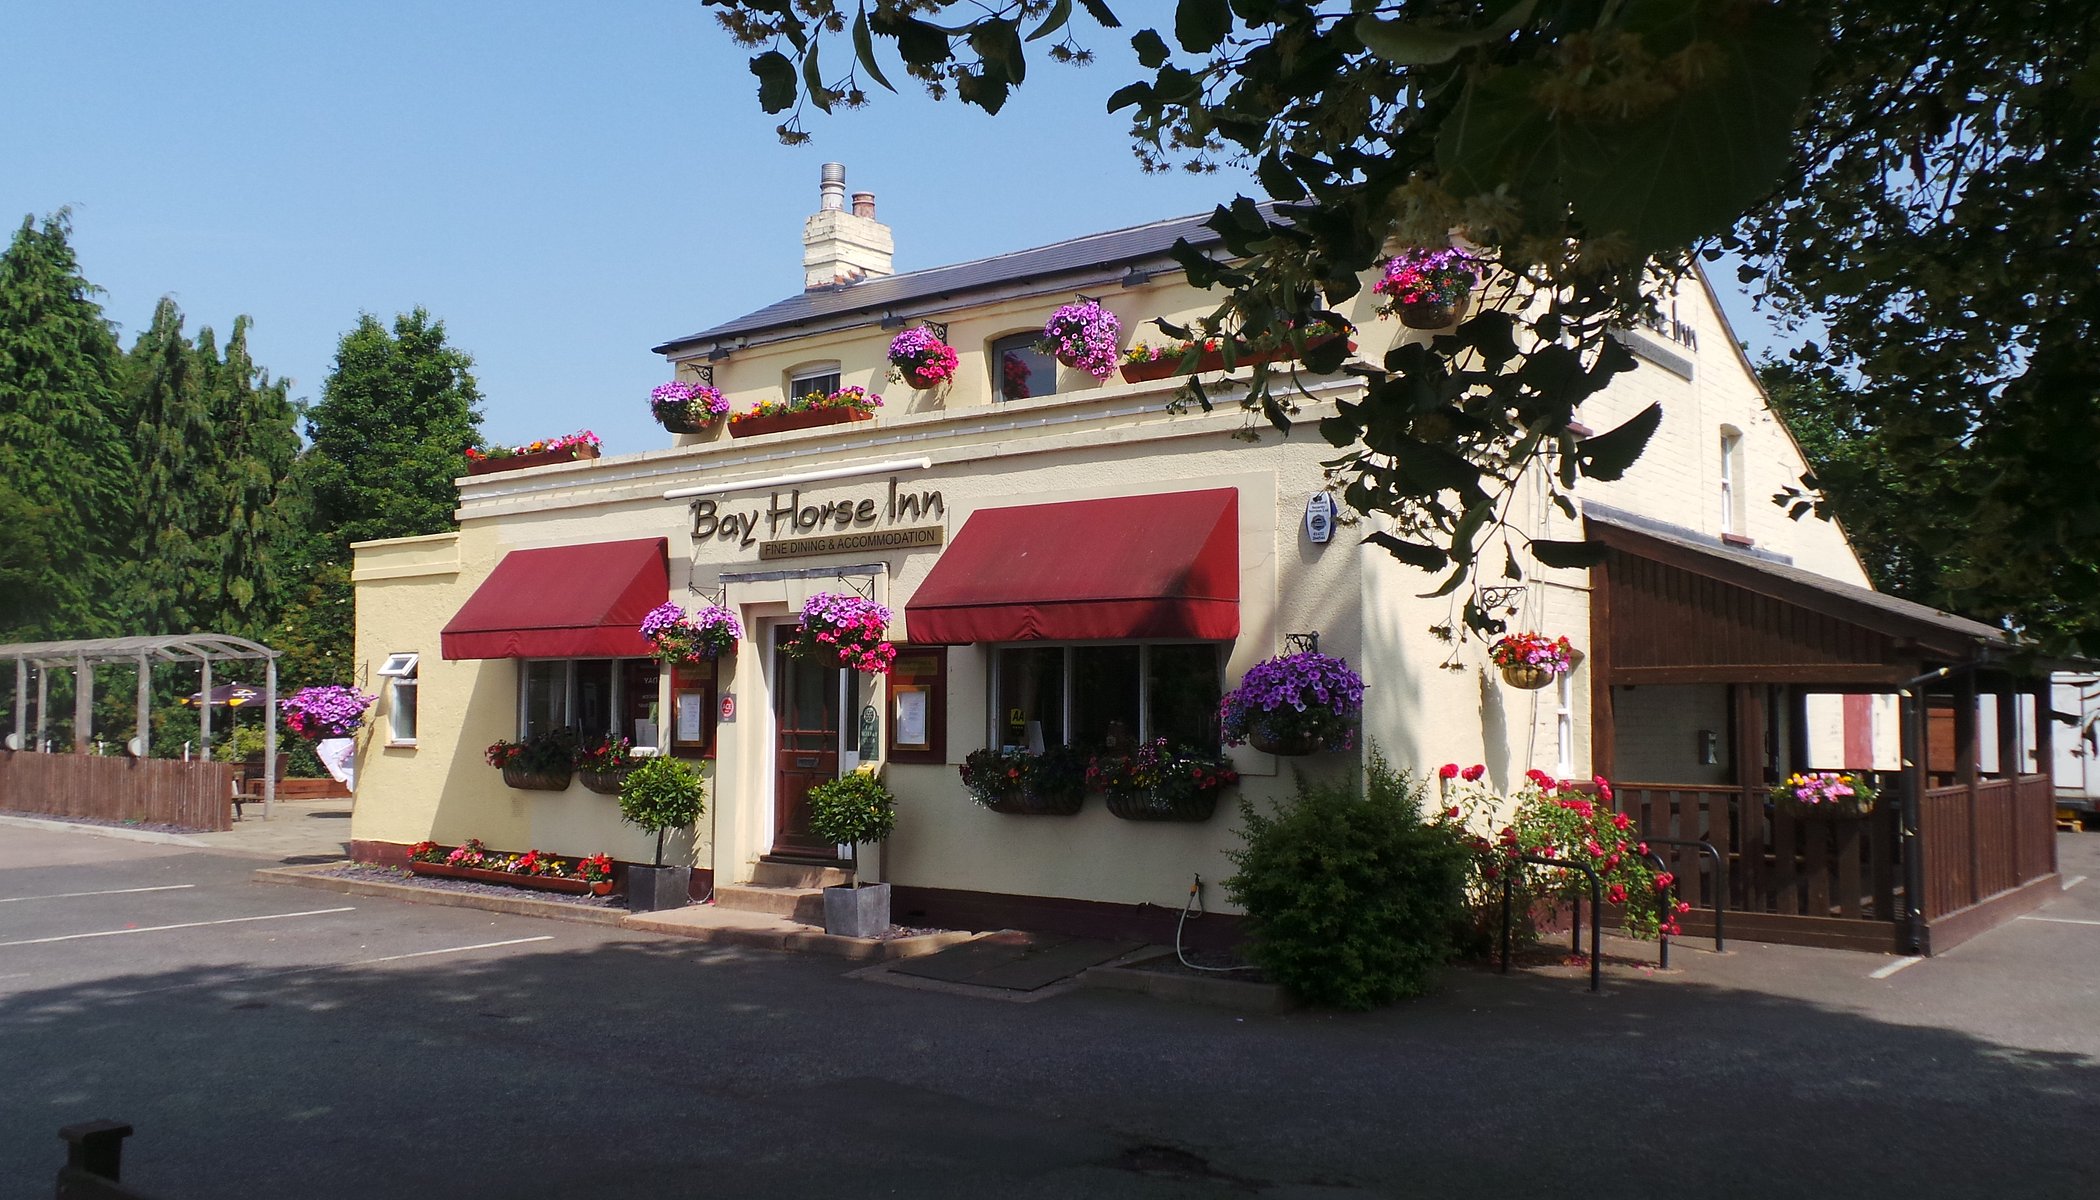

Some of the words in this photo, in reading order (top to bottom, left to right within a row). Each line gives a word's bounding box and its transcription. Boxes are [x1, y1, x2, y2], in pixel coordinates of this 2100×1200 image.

[1672, 300, 1697, 352] Inn
[690, 499, 758, 547] Bay
[767, 489, 877, 533] Horse
[889, 476, 944, 518] Inn
[765, 542, 787, 555] FINE
[790, 539, 826, 553] DINING
[828, 539, 836, 550] &
[837, 529, 935, 549] ACCOMMODATION
[1012, 710, 1025, 721] AA
